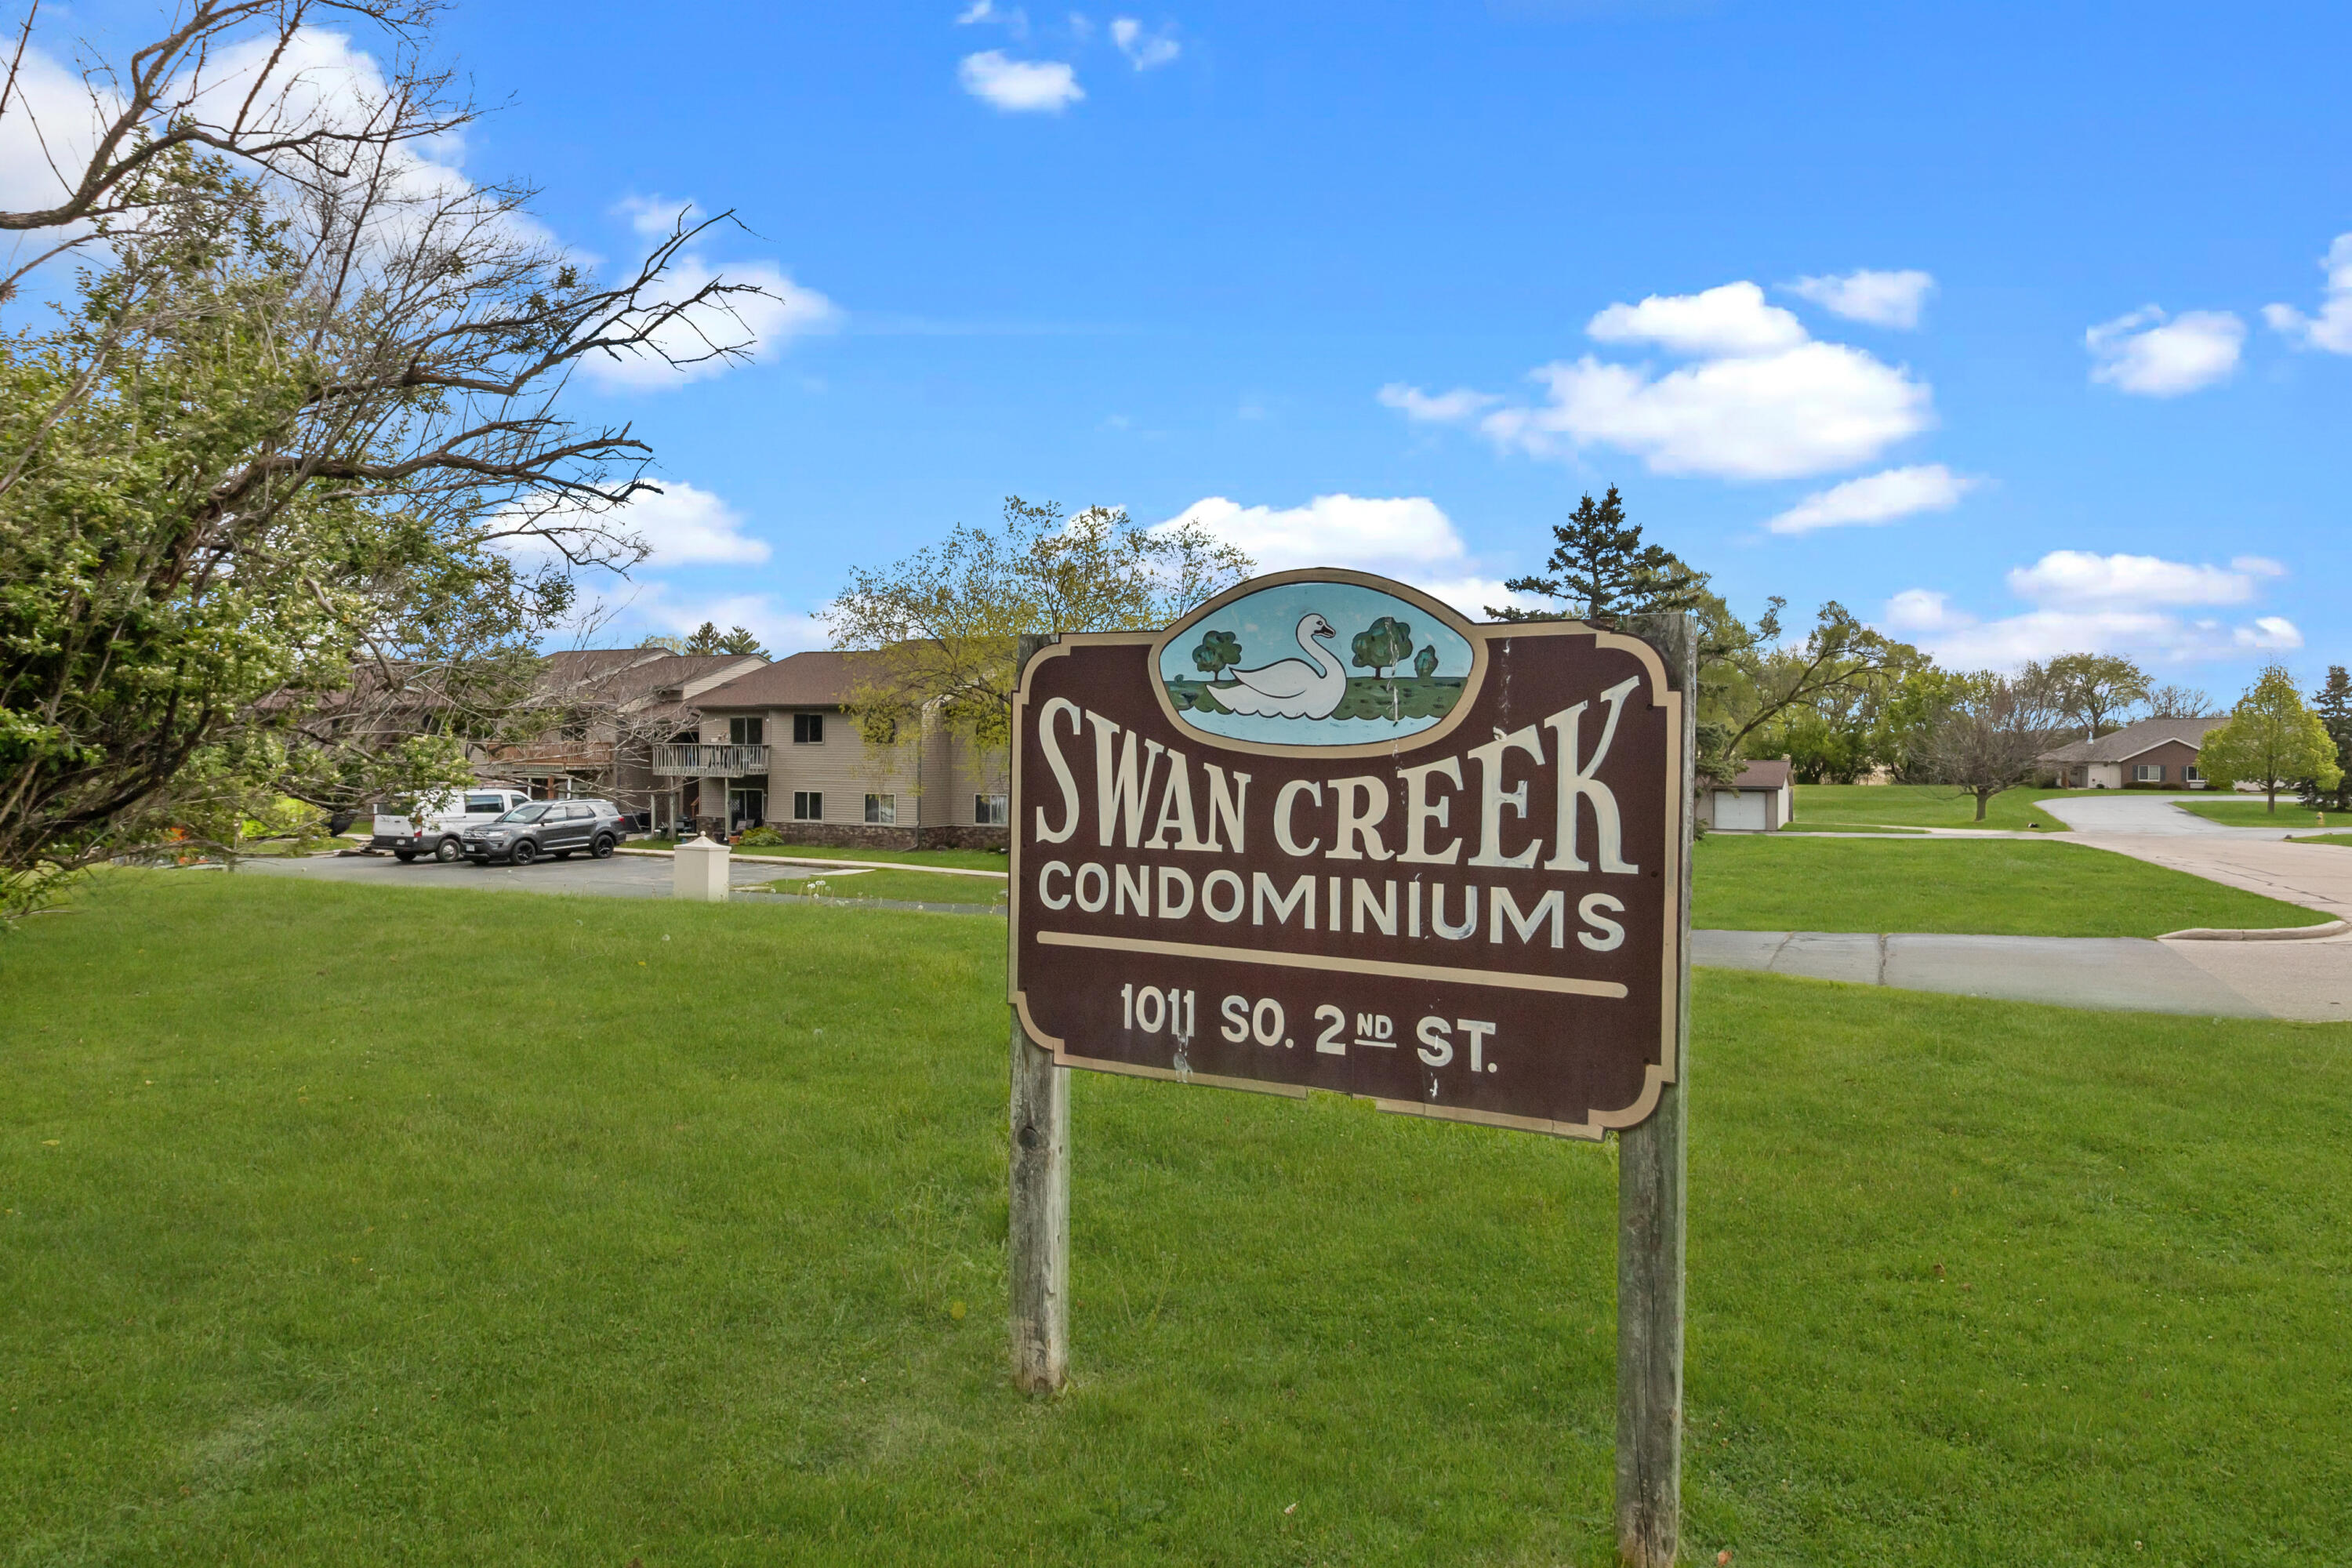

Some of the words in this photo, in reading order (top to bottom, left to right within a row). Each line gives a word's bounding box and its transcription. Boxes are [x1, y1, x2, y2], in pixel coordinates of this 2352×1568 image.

[1036, 697, 1252, 854] SWAN
[1273, 675, 1641, 875] CREEK
[1038, 860, 1626, 952] CONDOMINIUMS
[1121, 983, 1196, 1036] 1011
[1221, 995, 1294, 1049] SO.
[1315, 1004, 1397, 1055] 2ND
[1417, 1015, 1497, 1073] ST.
